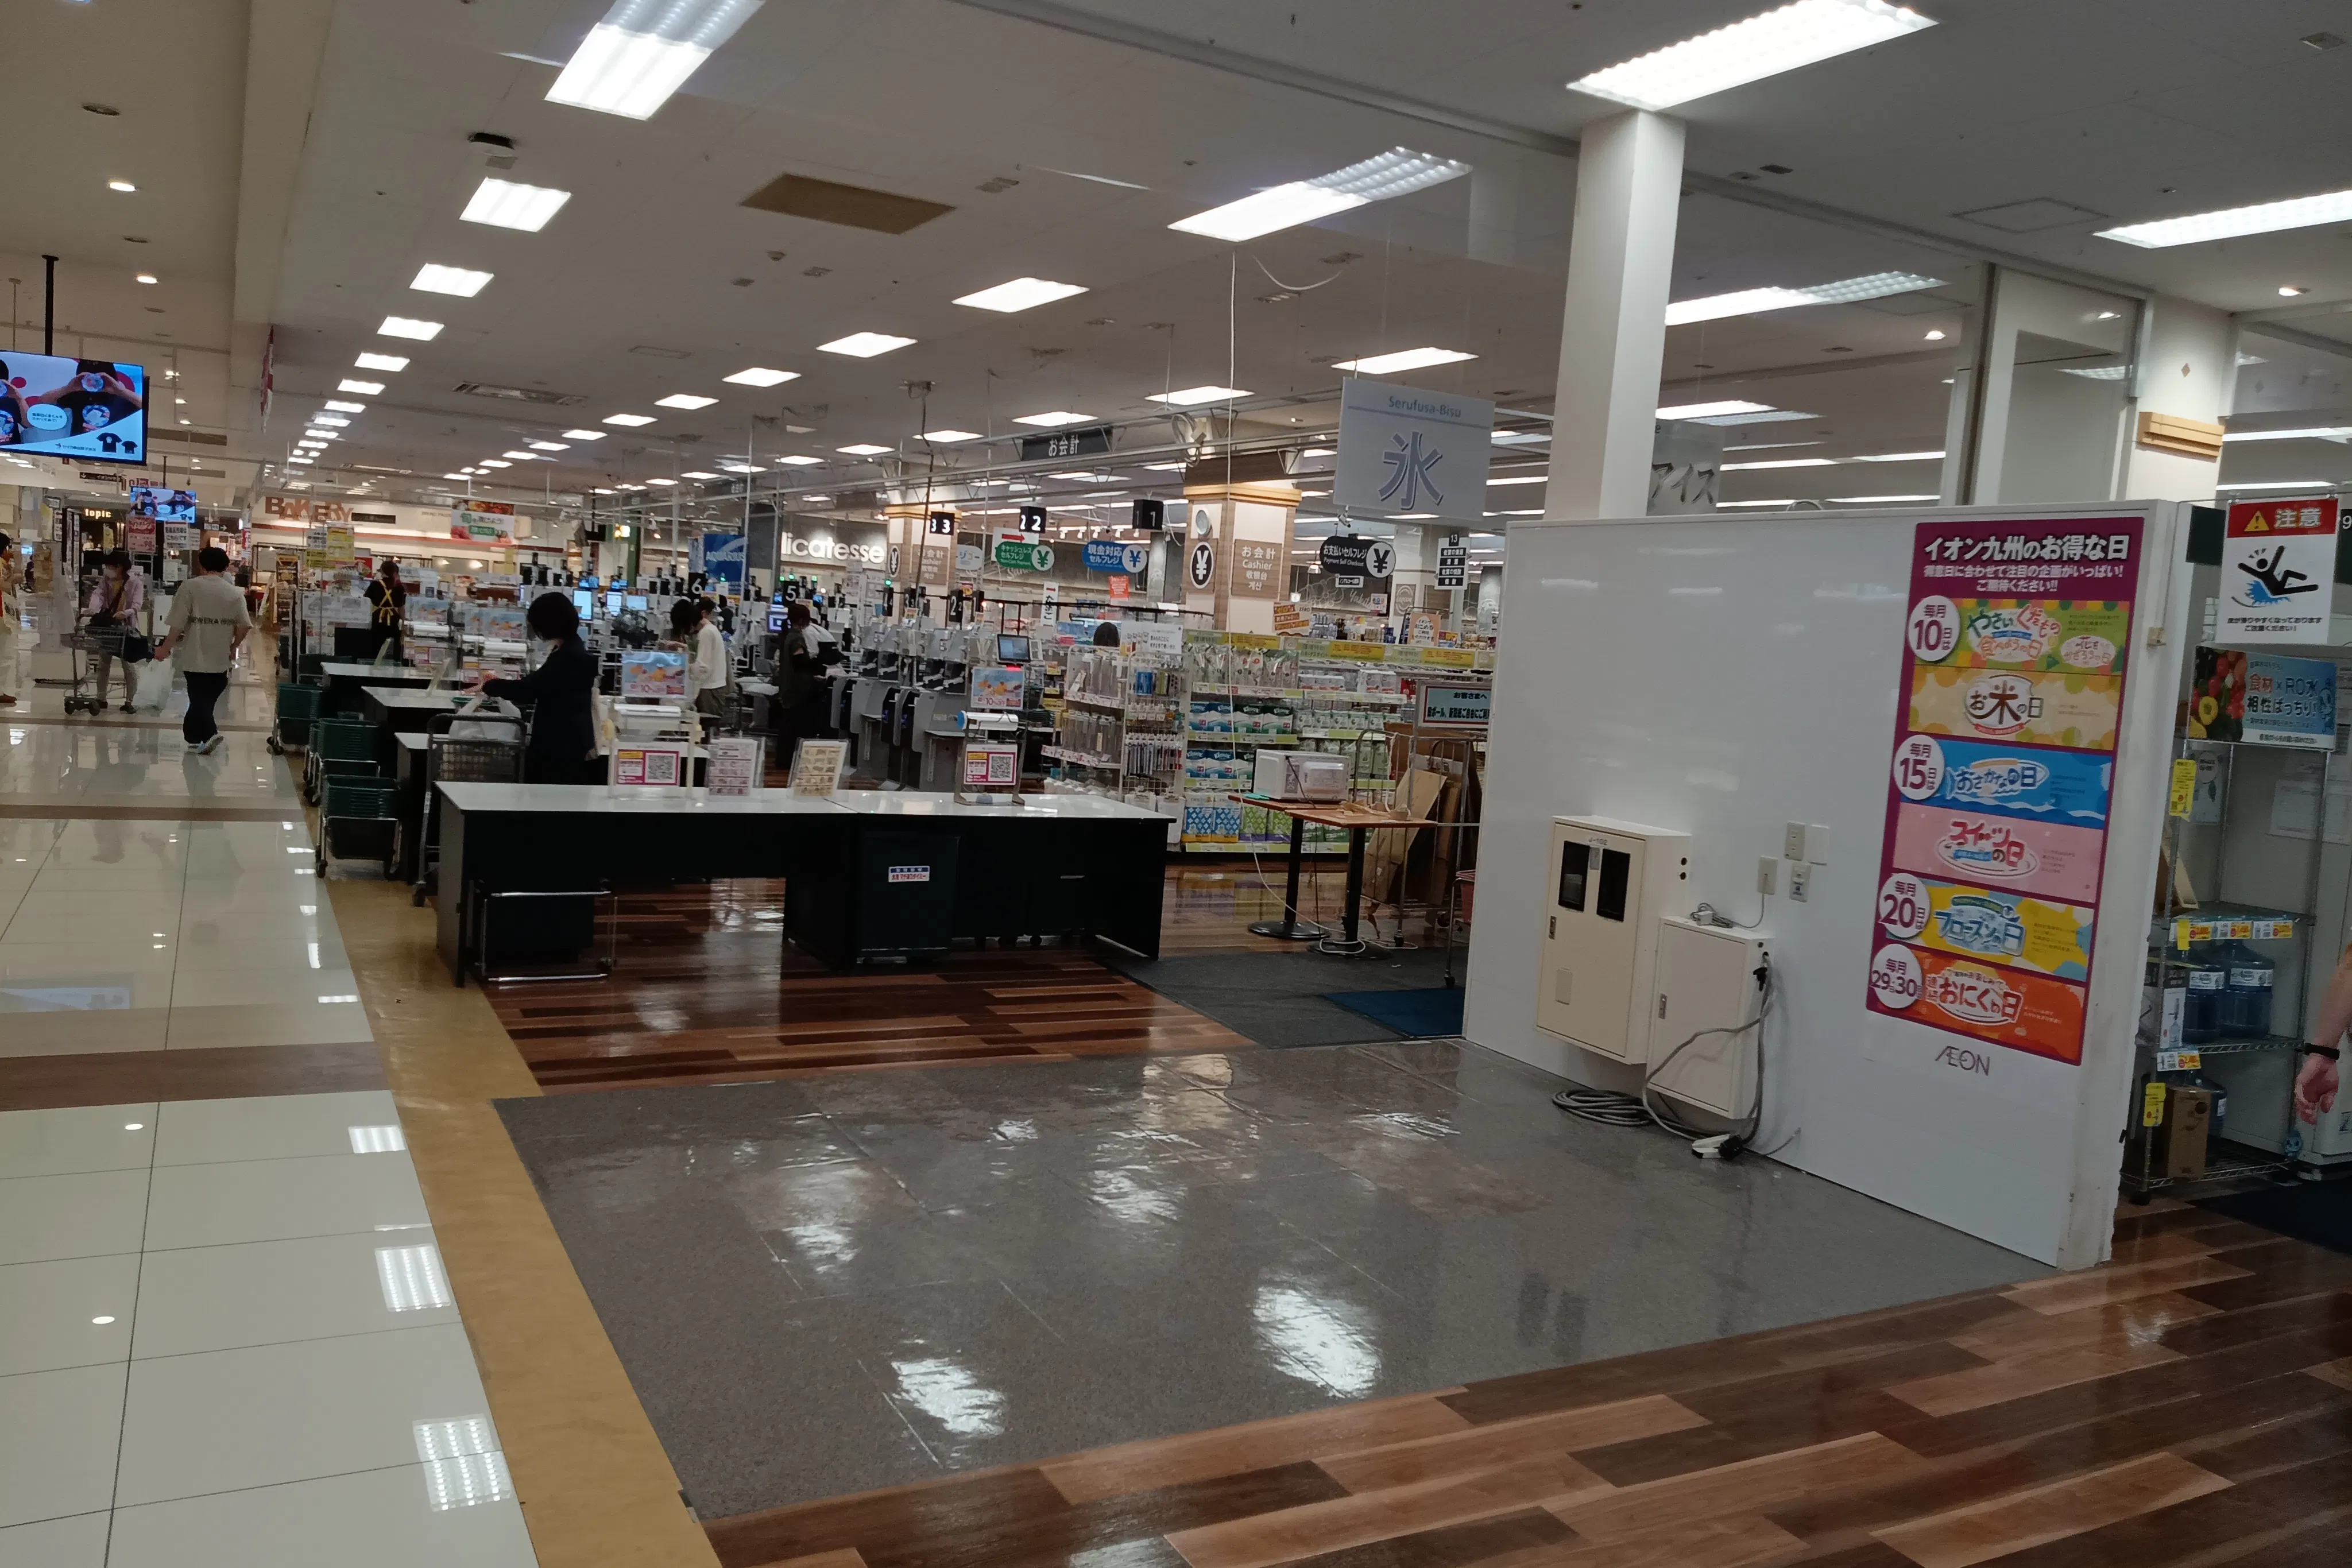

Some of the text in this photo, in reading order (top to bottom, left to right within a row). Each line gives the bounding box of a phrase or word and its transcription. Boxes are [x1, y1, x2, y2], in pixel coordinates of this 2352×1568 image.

[1388, 396, 1461, 417] Serufusa-Bisu
[1049, 434, 1080, 456] お会計
[1379, 431, 1444, 510] 氷
[85, 509, 111, 519] topic
[265, 497, 354, 524] BAKERY
[2274, 508, 2322, 528] 注意
[942, 520, 950, 533] 3
[1031, 516, 1041, 531] 2
[1150, 511, 1156, 527] 1
[1451, 534, 1457, 543] 13
[1088, 544, 1123, 556] 現金対応
[1241, 545, 1276, 560] お会計
[1323, 544, 1367, 559] お支払いセルフレジ
[1925, 535, 2129, 560] イオン九州のお得な日
[1001, 552, 1024, 560] セルフレジ
[1089, 555, 1120, 564] セルフレジ
[1242, 559, 1272, 570] Cashier
[691, 578, 702, 594] 6
[786, 585, 797, 601] 5
[950, 596, 957, 616] 2
[1925, 605, 1946, 618] 毎月
[1970, 680, 2044, 725] お米の日
[1909, 742, 1931, 758] 毎月
[1895, 881, 1917, 897] 毎月
[1886, 958, 1907, 975] 毎月
